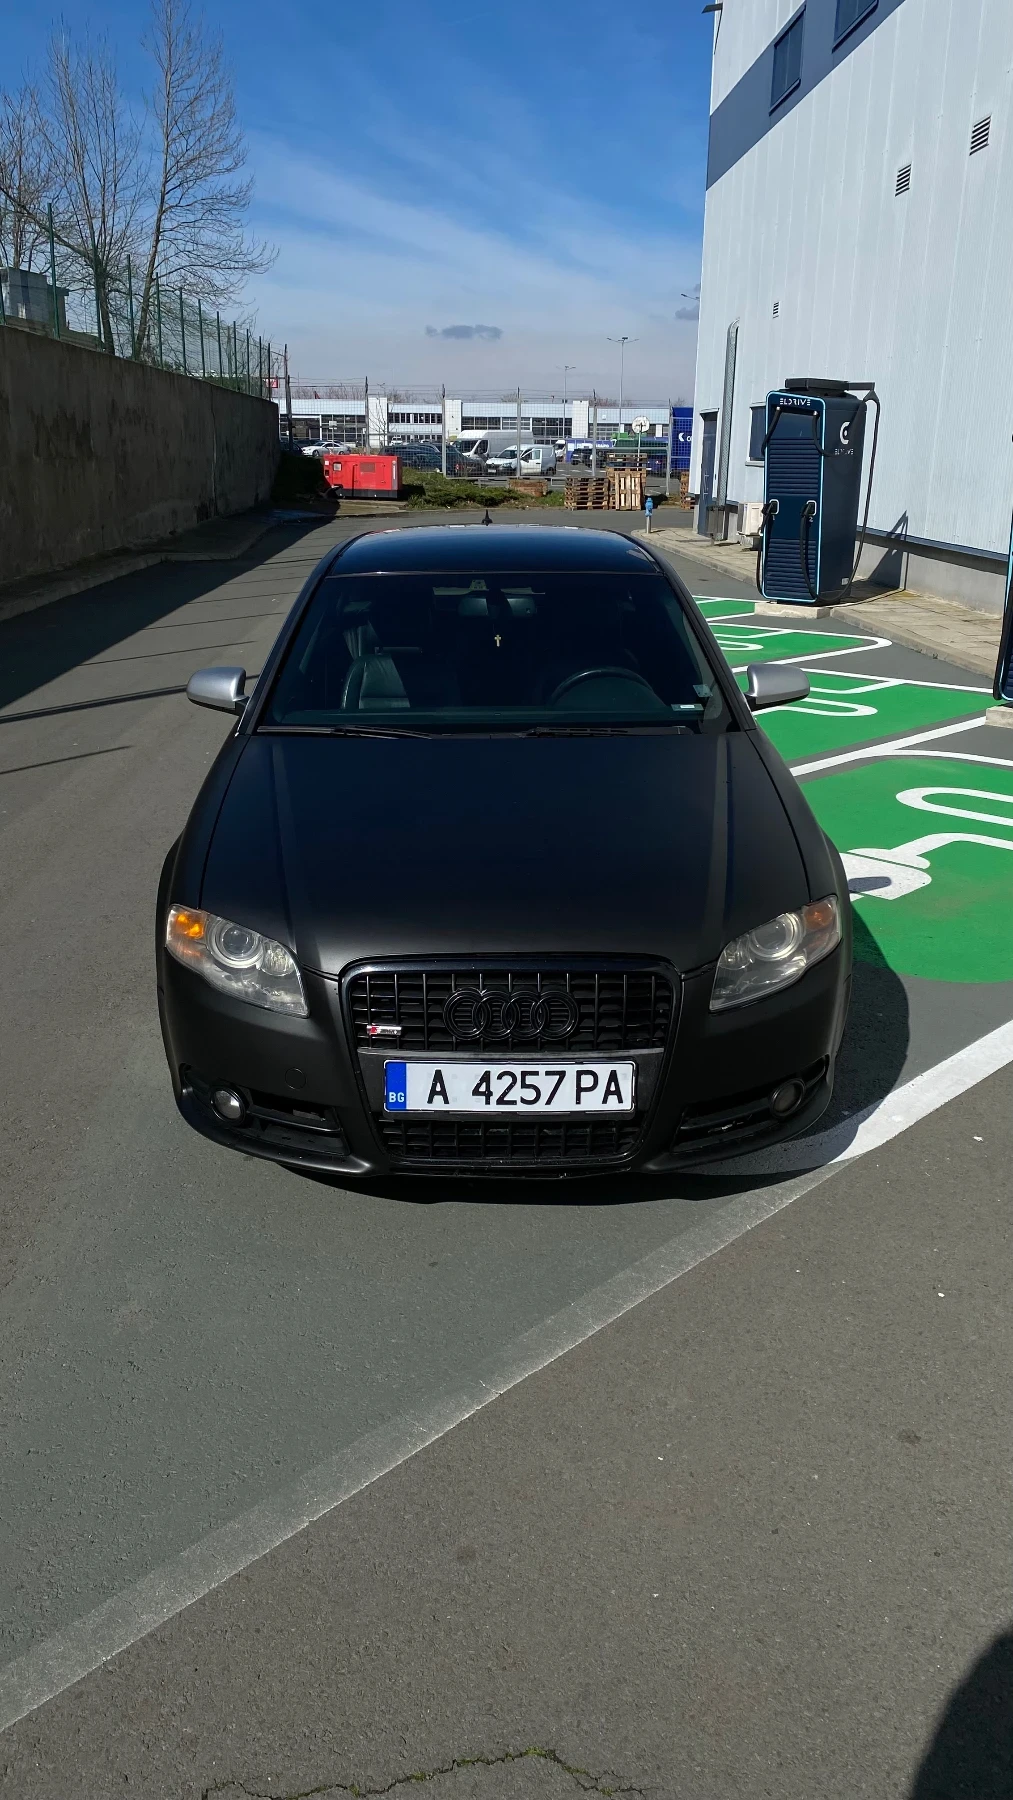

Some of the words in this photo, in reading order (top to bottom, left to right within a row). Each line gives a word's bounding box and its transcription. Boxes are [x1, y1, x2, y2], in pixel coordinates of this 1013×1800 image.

[780, 398, 811, 406] ELDRIVE
[426, 1069, 450, 1105] A
[471, 1070, 567, 1106] 4257
[575, 1069, 624, 1105] PA
[388, 1091, 405, 1103] BG
